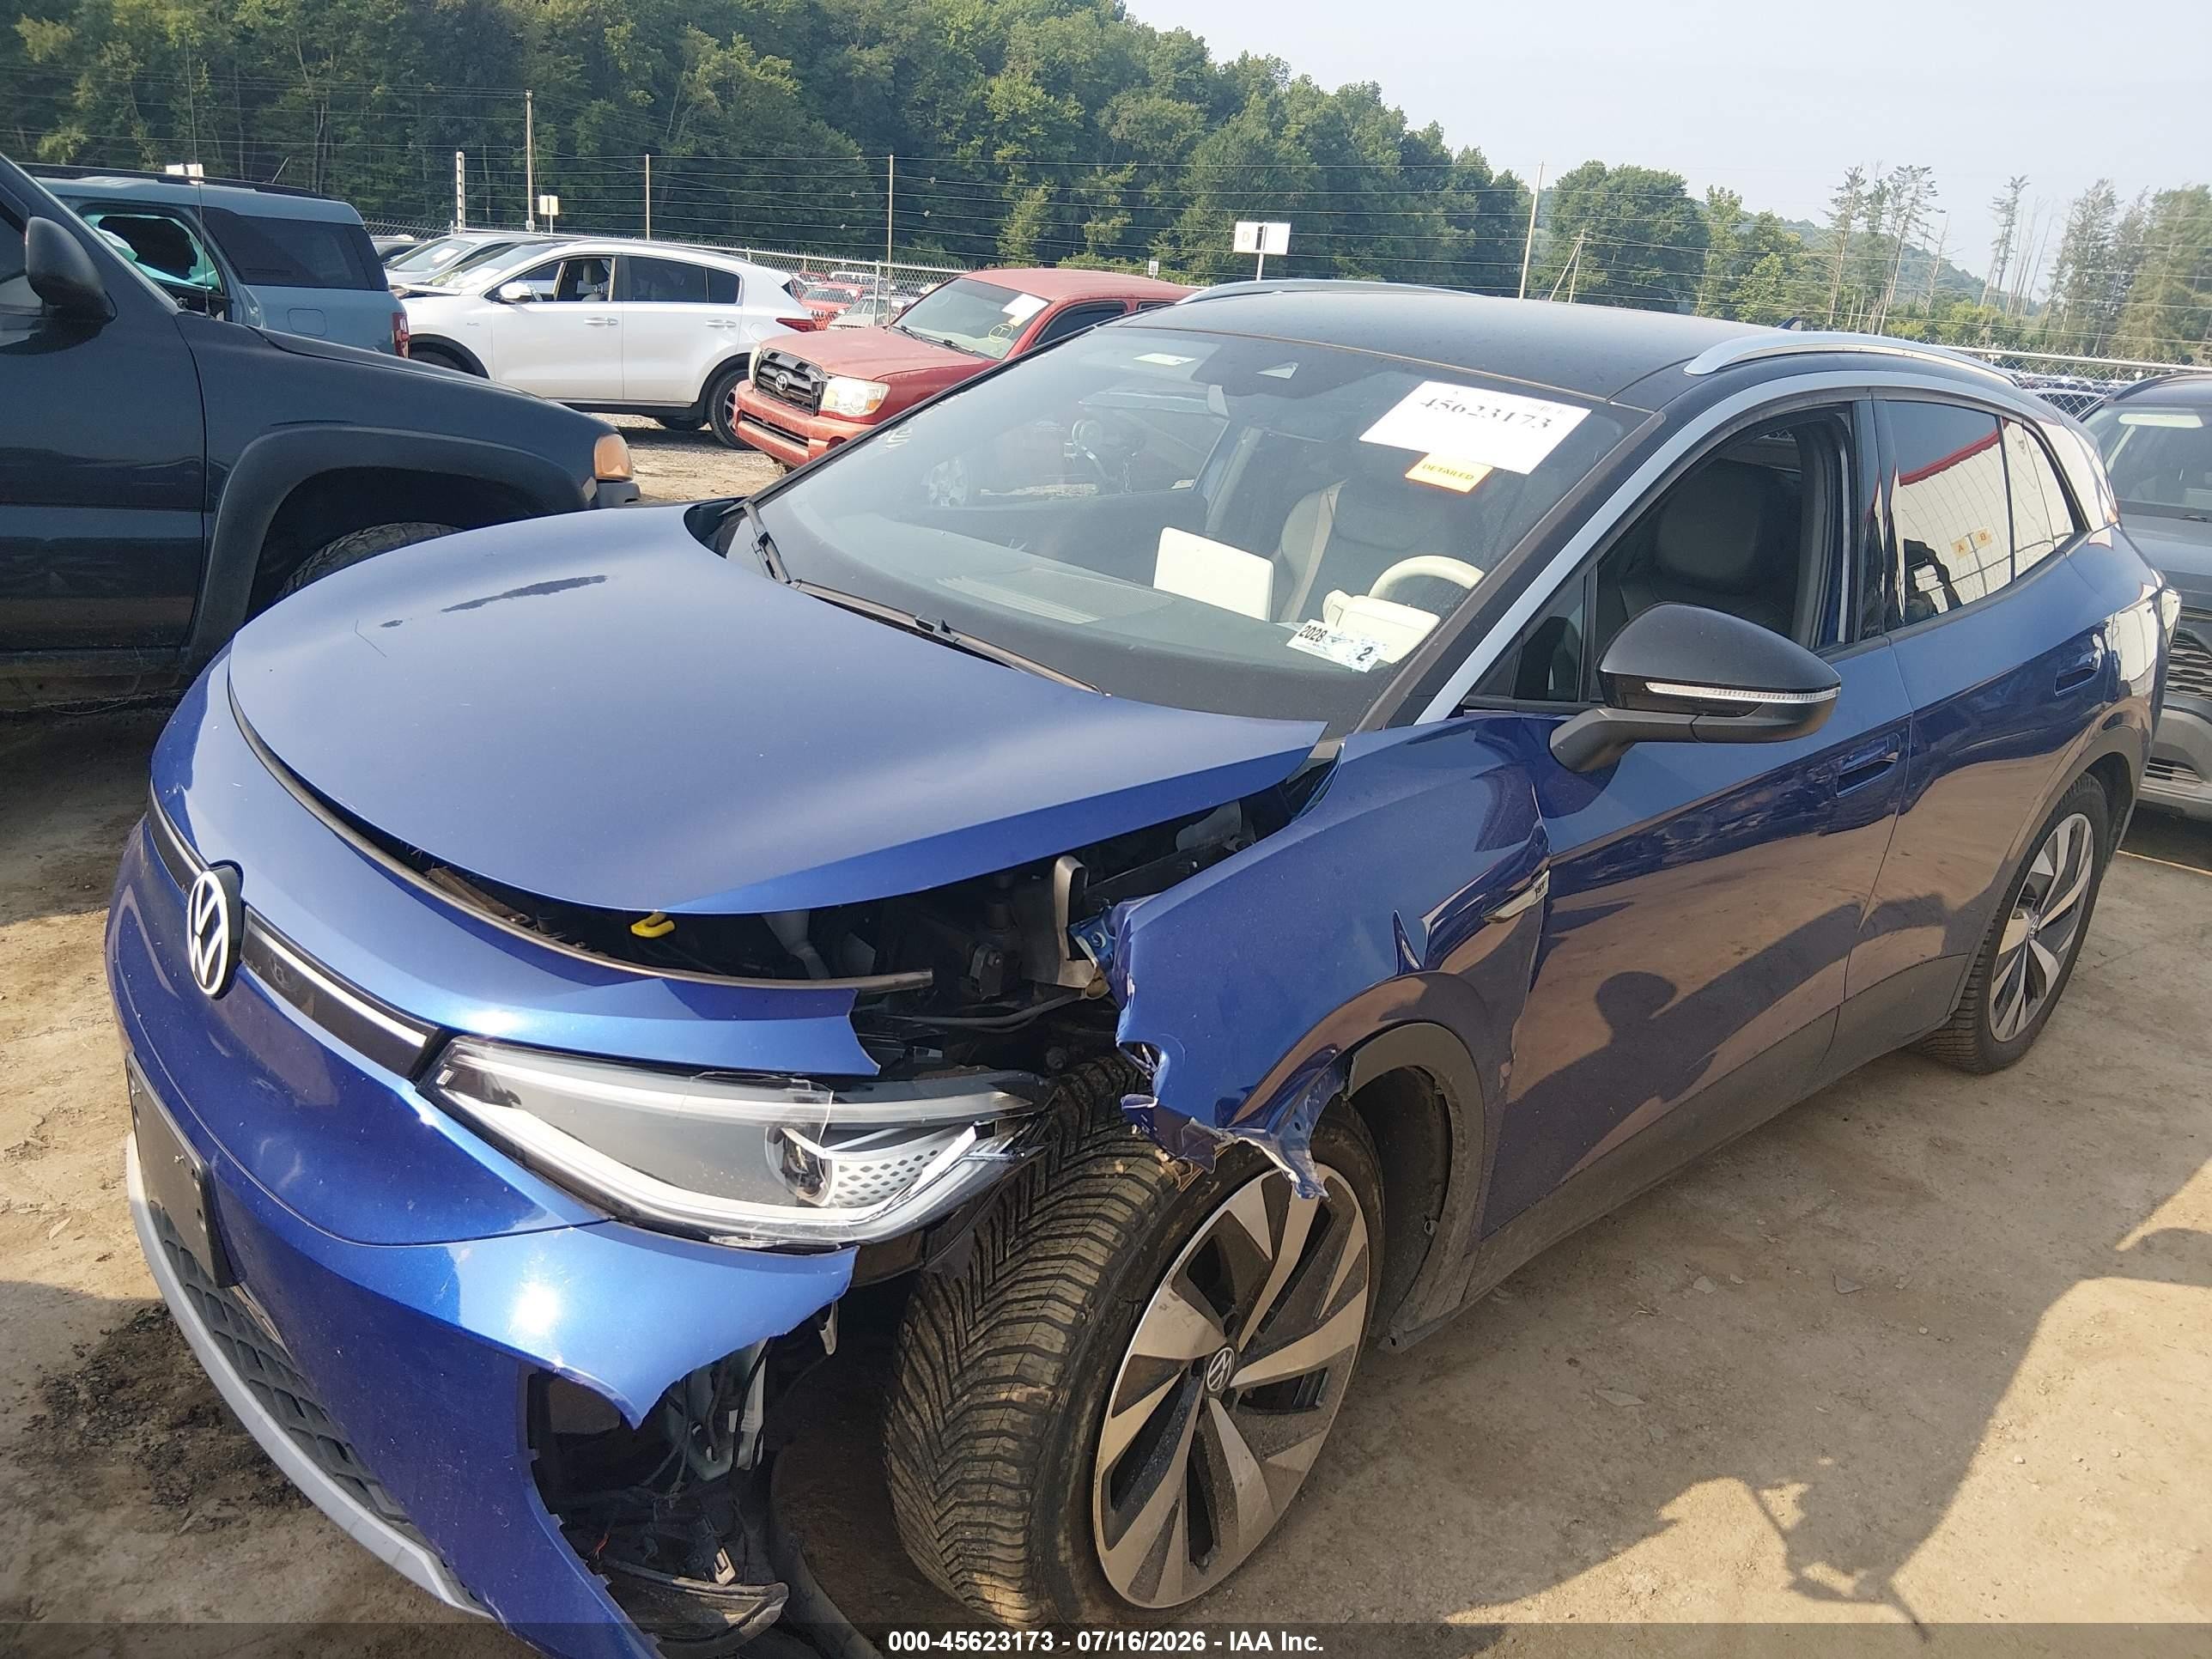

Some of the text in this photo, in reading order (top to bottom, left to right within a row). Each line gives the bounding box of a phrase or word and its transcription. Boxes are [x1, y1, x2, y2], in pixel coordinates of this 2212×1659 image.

[1419, 398, 1553, 428] 45623173
[1422, 464, 1475, 480] DETAILED
[1298, 625, 1374, 662] 2028 2
